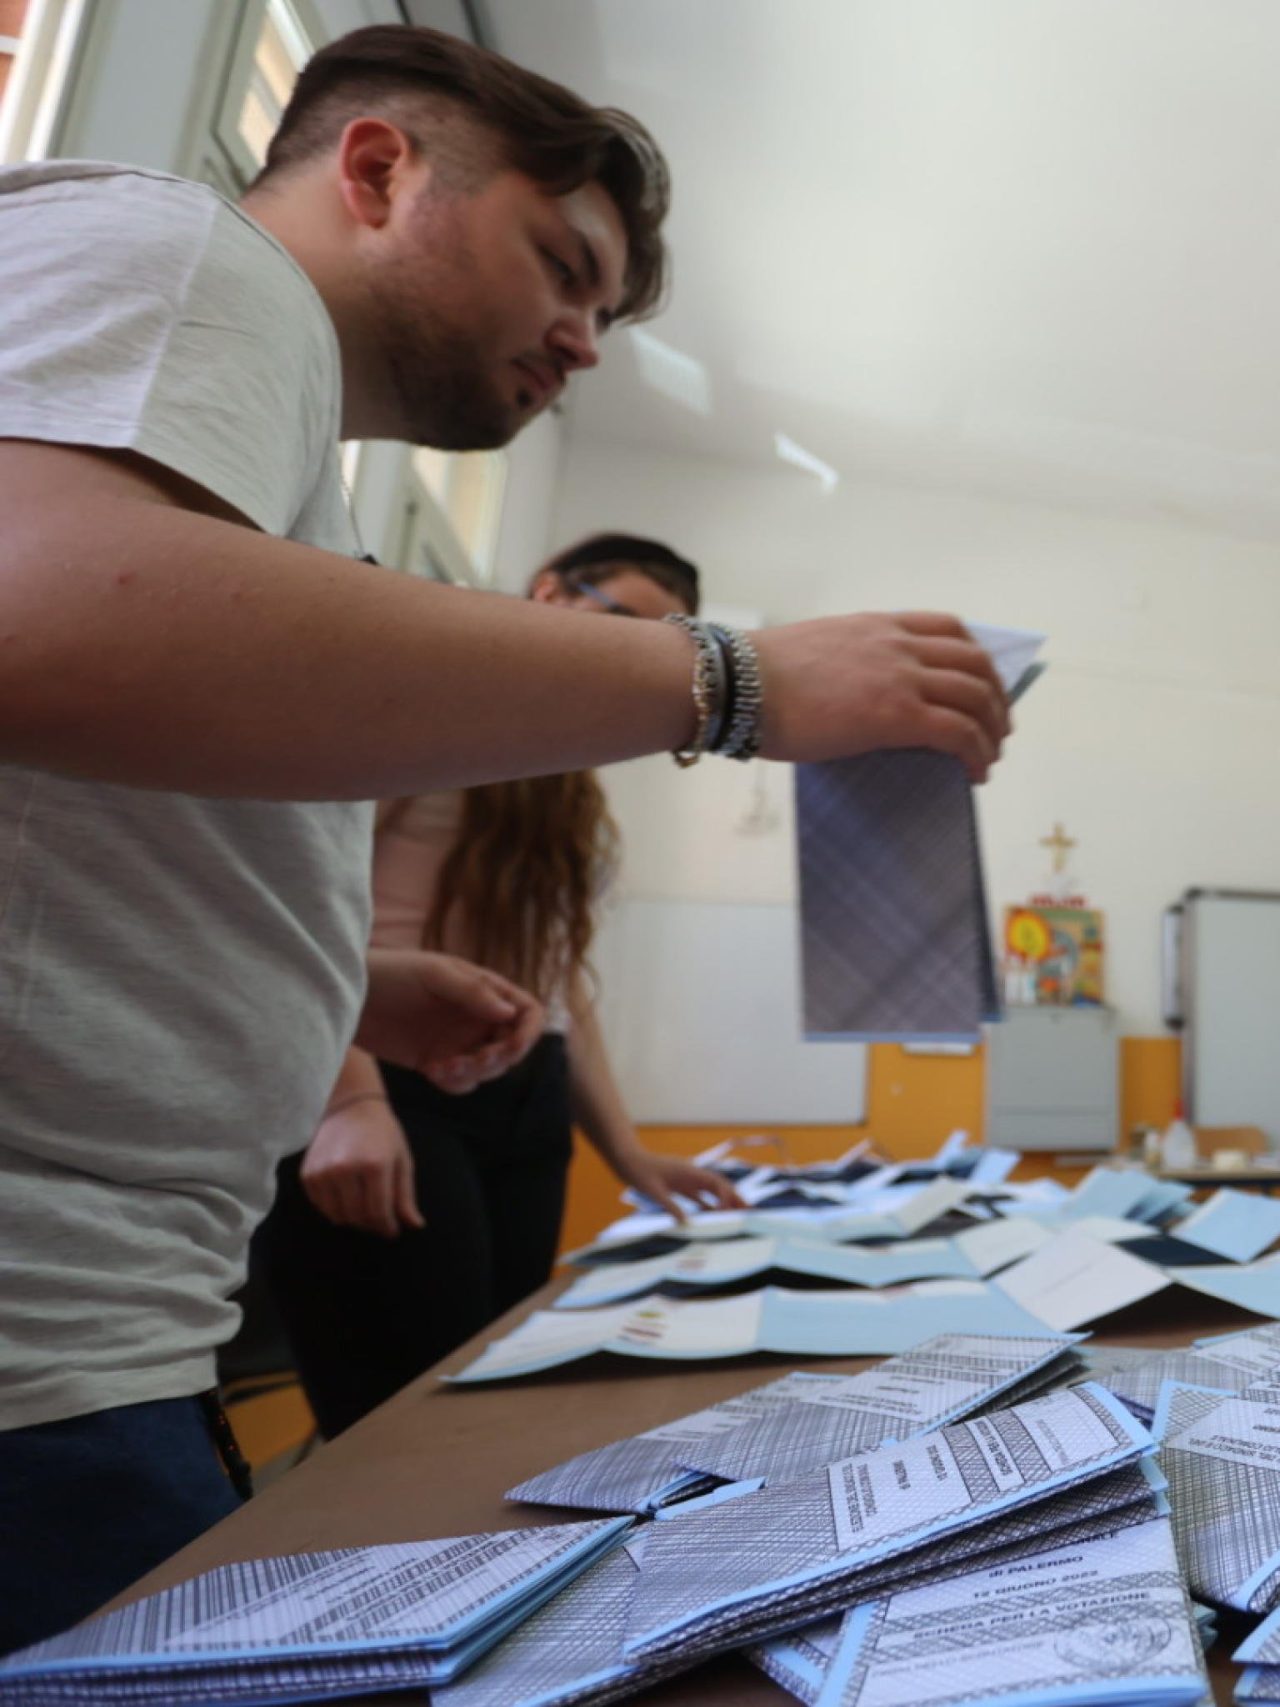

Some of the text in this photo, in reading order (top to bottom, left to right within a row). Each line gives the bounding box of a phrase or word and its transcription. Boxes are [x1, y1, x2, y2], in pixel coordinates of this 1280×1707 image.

[988, 1556, 1084, 1578] di PALERMO
[974, 1570, 1099, 1600] 12 GIUGNO 2022
[913, 1592, 1148, 1640] SCHEDA PER LA VOTAZIONE
